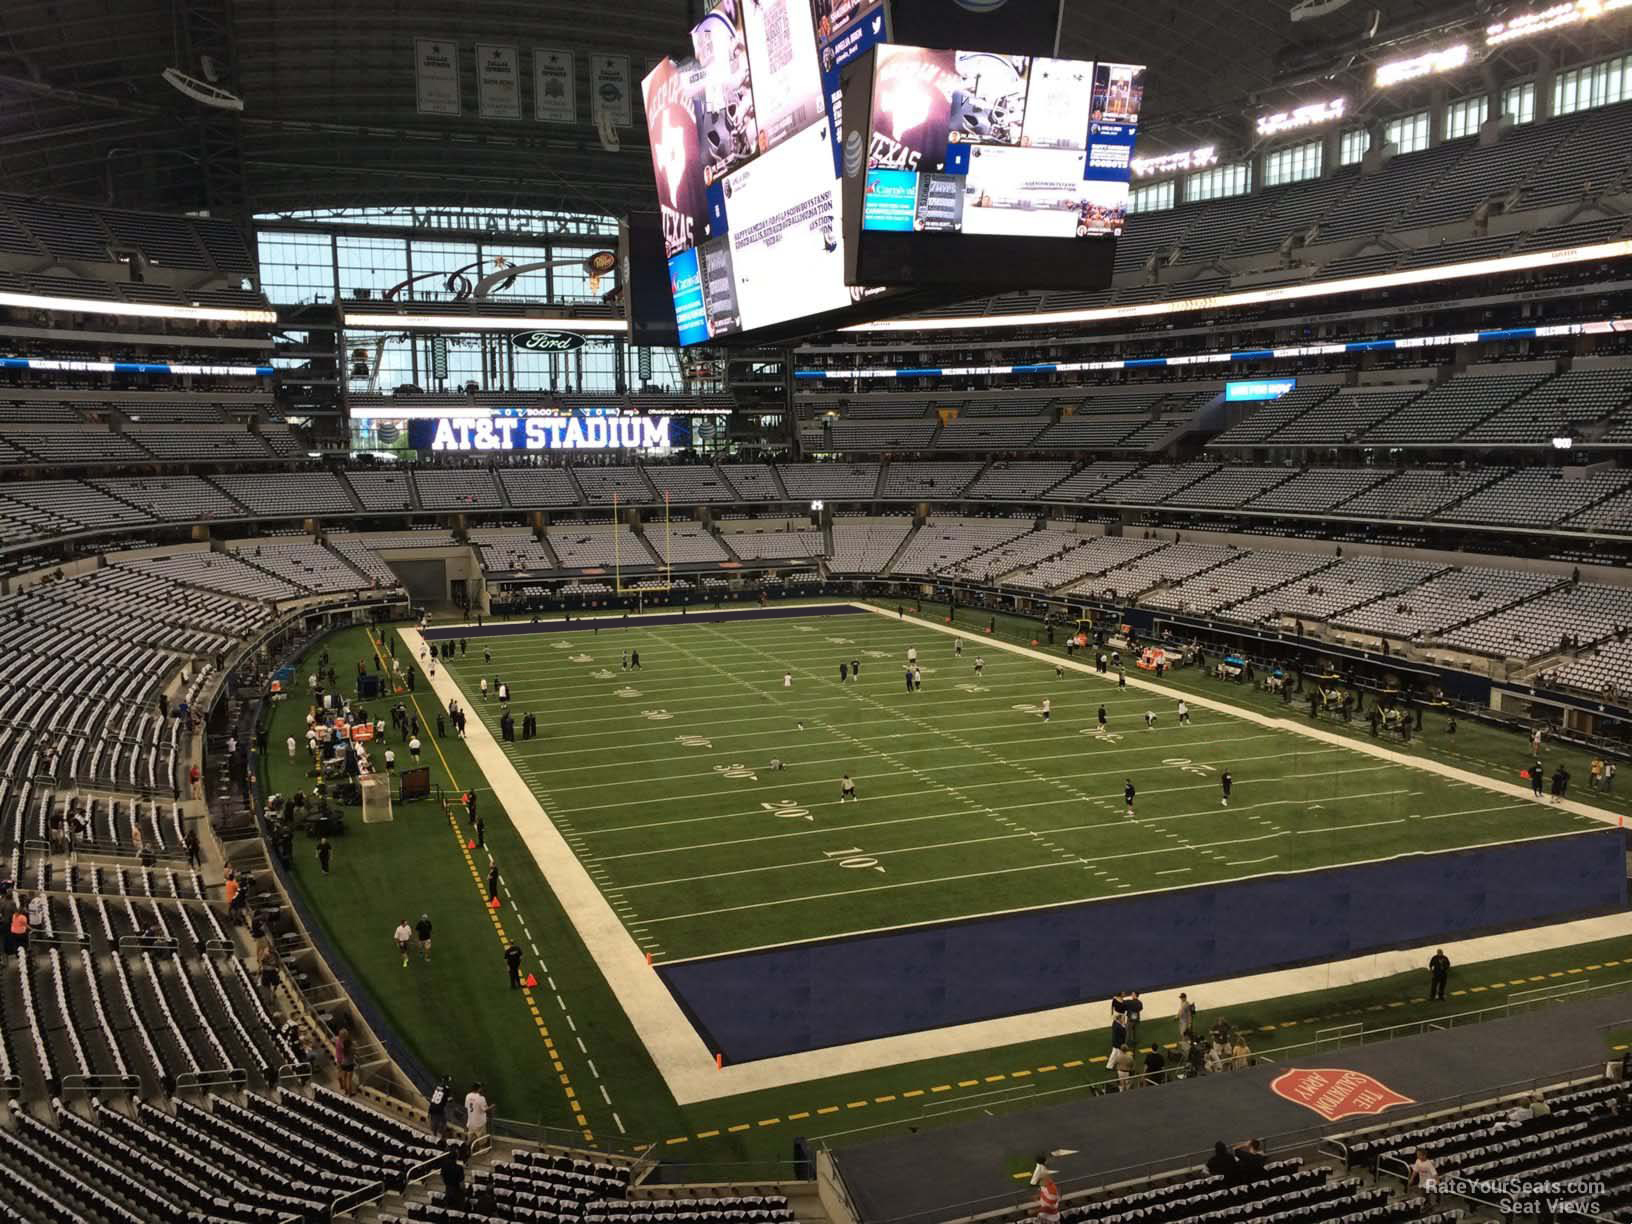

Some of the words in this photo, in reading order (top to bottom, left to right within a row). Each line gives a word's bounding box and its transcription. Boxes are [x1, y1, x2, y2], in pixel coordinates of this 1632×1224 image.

[869, 131, 922, 171] TEXAS
[661, 204, 694, 248] TEXAS
[526, 332, 572, 349] Ford
[431, 417, 518, 450] AT&T
[525, 416, 671, 450] STADIUM
[712, 763, 756, 779] 30
[761, 800, 811, 818] 20
[823, 847, 879, 868] 10
[1294, 1071, 1329, 1100] ARMY
[1312, 1072, 1367, 1115] SALVATION
[1352, 1089, 1384, 1110] THE
